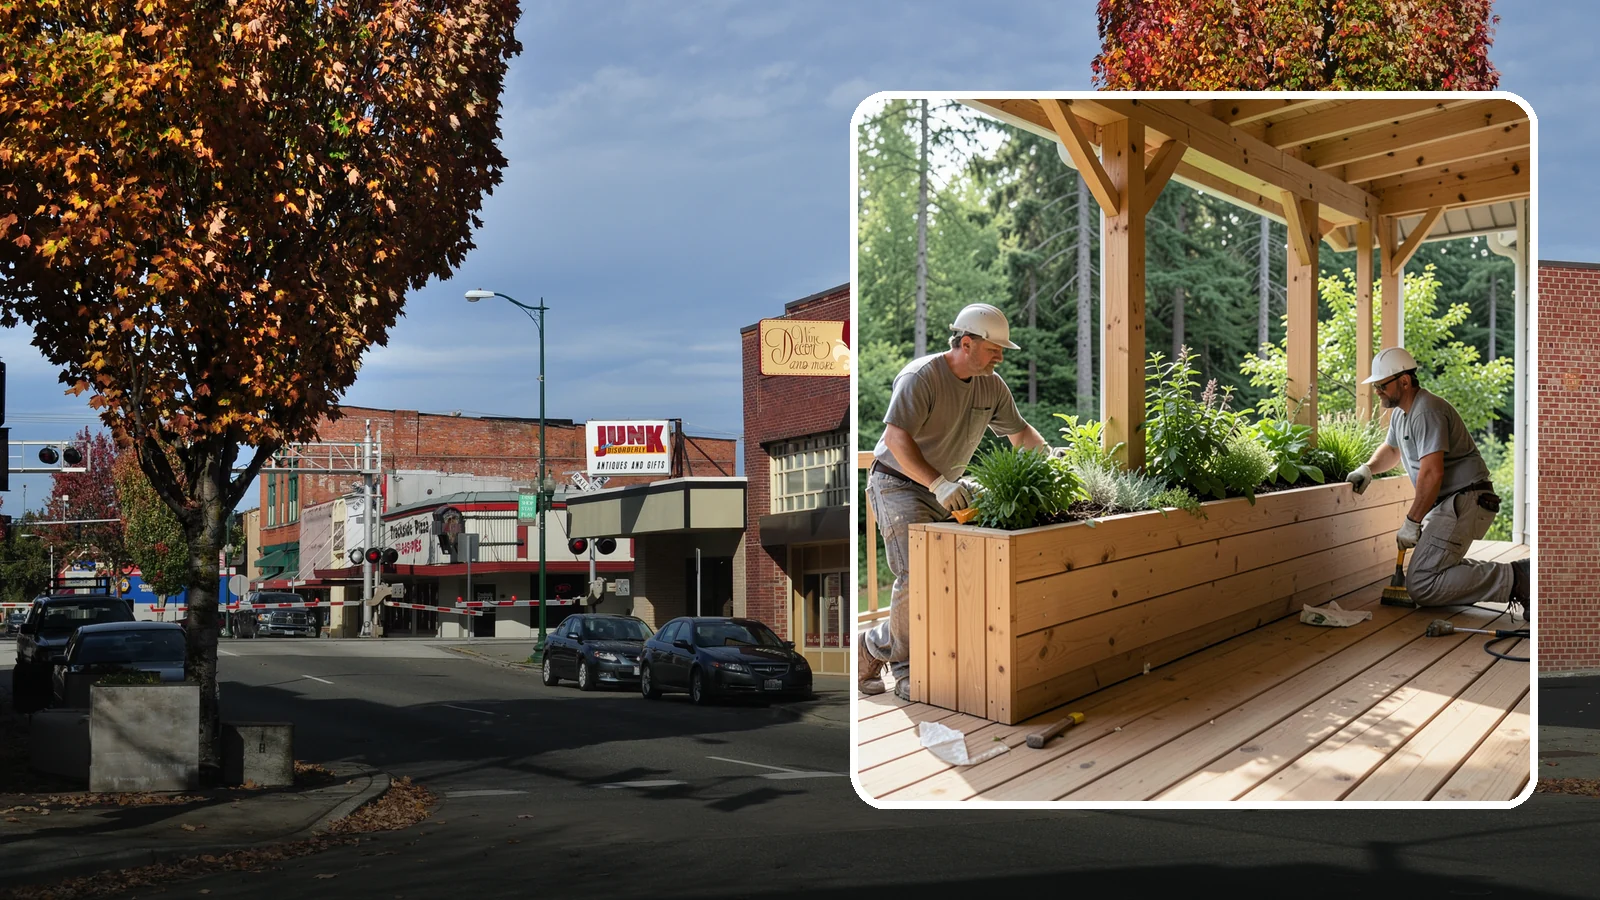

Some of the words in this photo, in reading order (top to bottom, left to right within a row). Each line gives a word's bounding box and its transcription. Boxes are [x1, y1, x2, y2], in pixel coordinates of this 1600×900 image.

[596, 425, 664, 457] JUNK
[597, 461, 628, 470] ANTIQUES
[631, 461, 644, 470] AND
[647, 460, 665, 469] GIFTS
[352, 498, 365, 511] CRO
